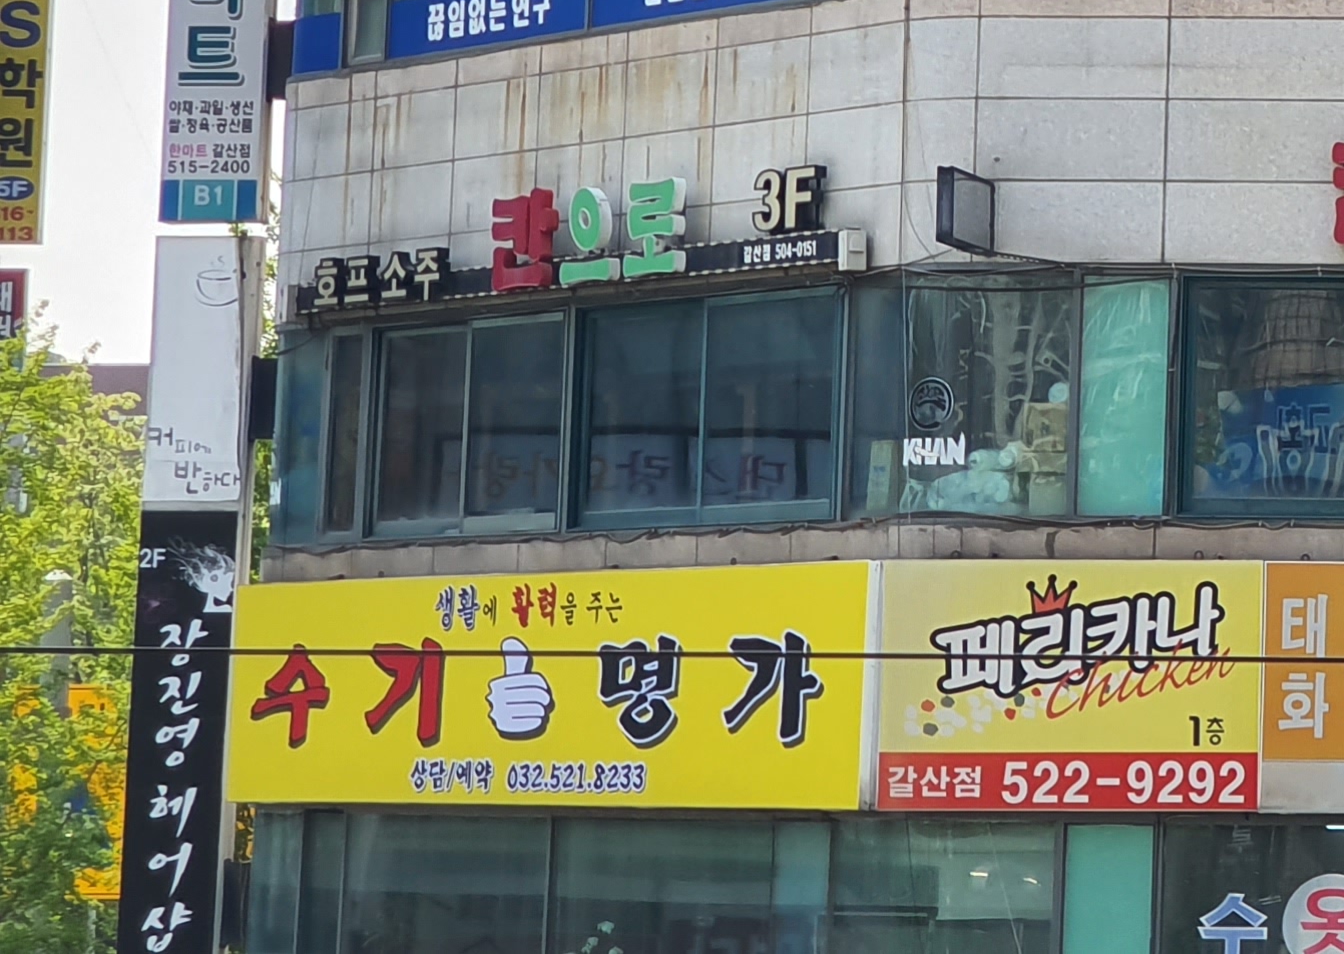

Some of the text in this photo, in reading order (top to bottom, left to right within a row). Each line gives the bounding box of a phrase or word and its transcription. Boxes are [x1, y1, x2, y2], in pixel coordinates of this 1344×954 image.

[167, 159, 251, 174] 515-2400
[212, 143, 251, 159] 갈산점
[194, 184, 223, 206] B1
[752, 166, 817, 232] 3F
[314, 250, 440, 306] 호프 소주
[903, 431, 966, 466] KHAN
[173, 460, 242, 495] 반하다
[139, 548, 167, 569] 2F
[434, 582, 624, 631] 생활에 활력을 주는
[930, 581, 1225, 698] 페리카나
[1278, 593, 1331, 739] 태화
[250, 630, 824, 748] 수기 명가
[1187, 715, 1225, 747] 1층
[409, 757, 648, 794] 상담/예약 032.521.8233
[886, 760, 1246, 805] 갈산점 522-9292
